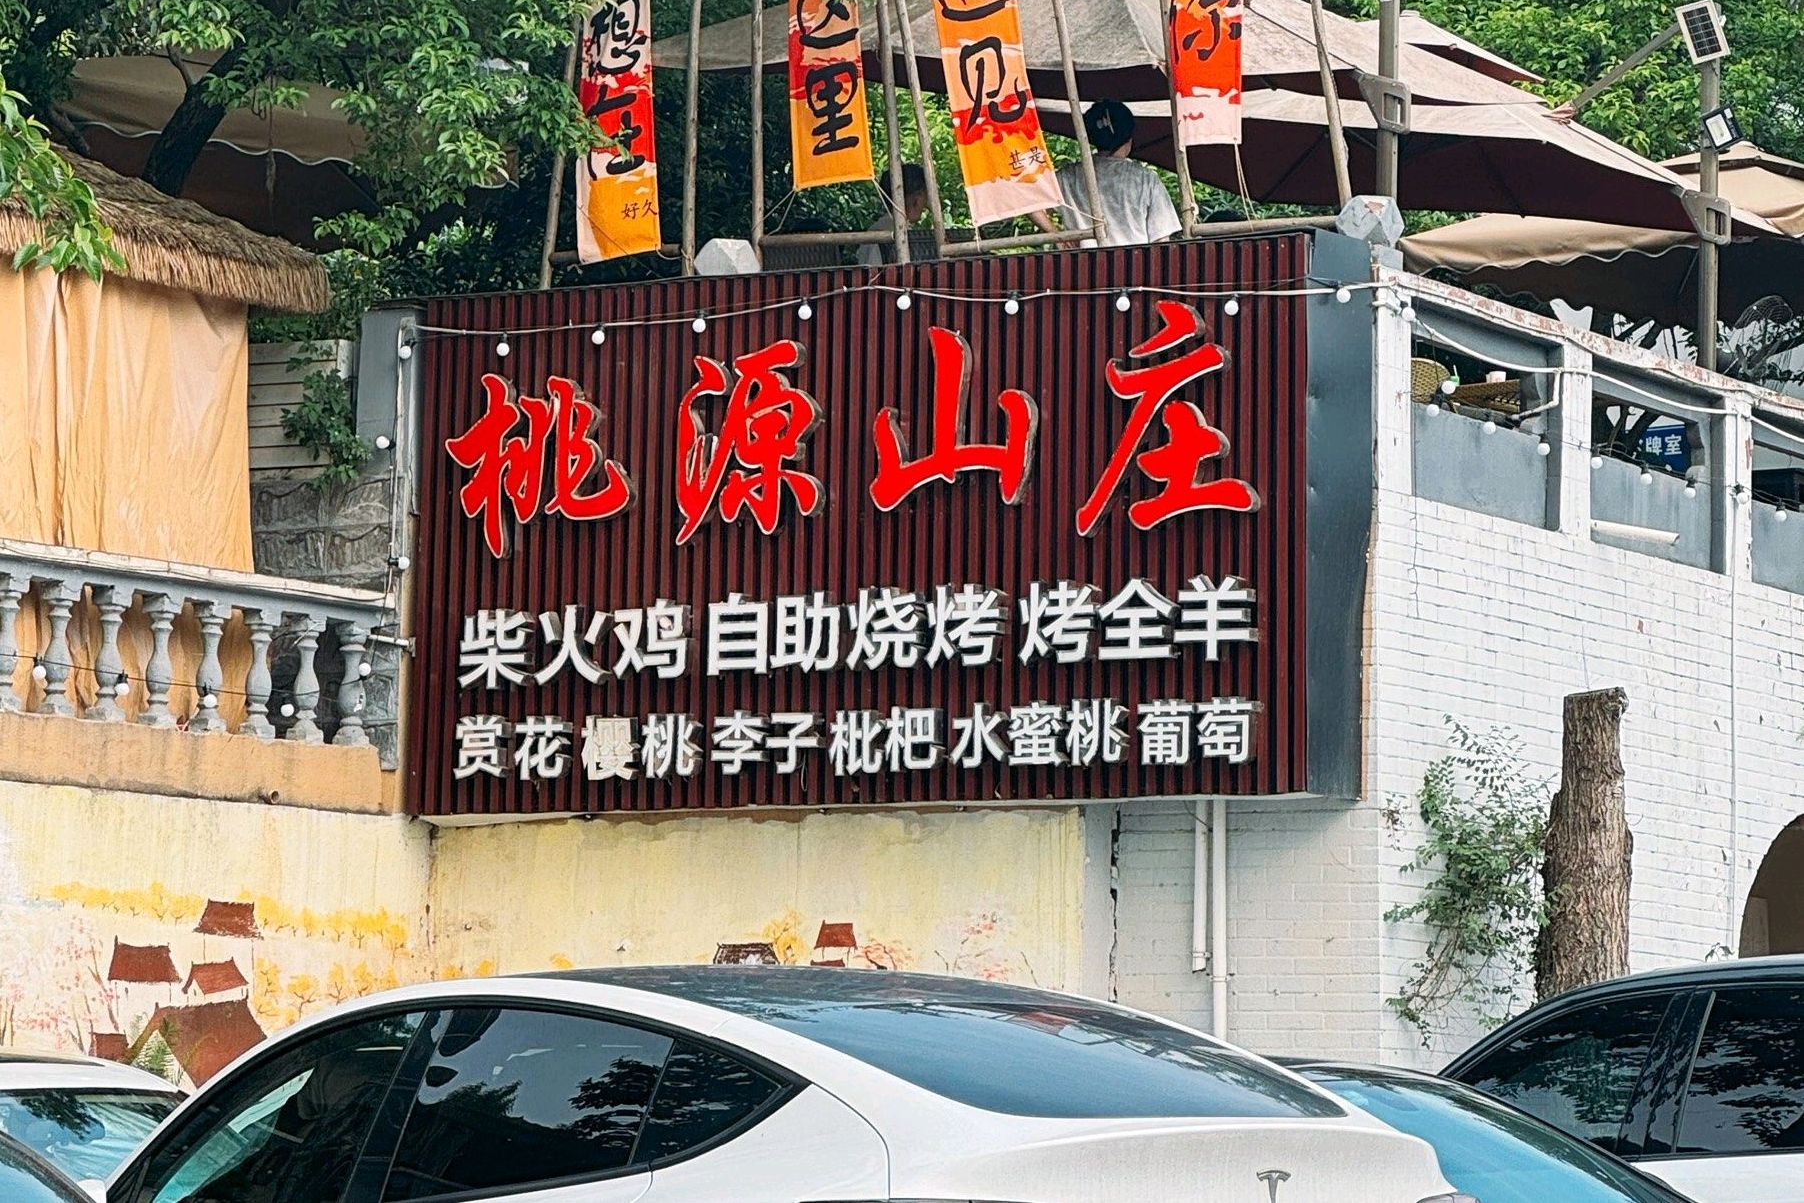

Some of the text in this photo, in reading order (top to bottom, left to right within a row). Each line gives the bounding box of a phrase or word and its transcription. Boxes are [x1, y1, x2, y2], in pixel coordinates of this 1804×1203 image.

[1008, 146, 1046, 170] 甚是
[621, 198, 658, 221] 好久
[446, 300, 1261, 559] 桃源山庄
[1636, 434, 1682, 457] 牌室
[459, 574, 1258, 690] 柴火鸡 自助烧烤 烤全羊
[454, 697, 1258, 780] 赏花 樱桃 李子 枇杷 水蜜桃 葡萄
